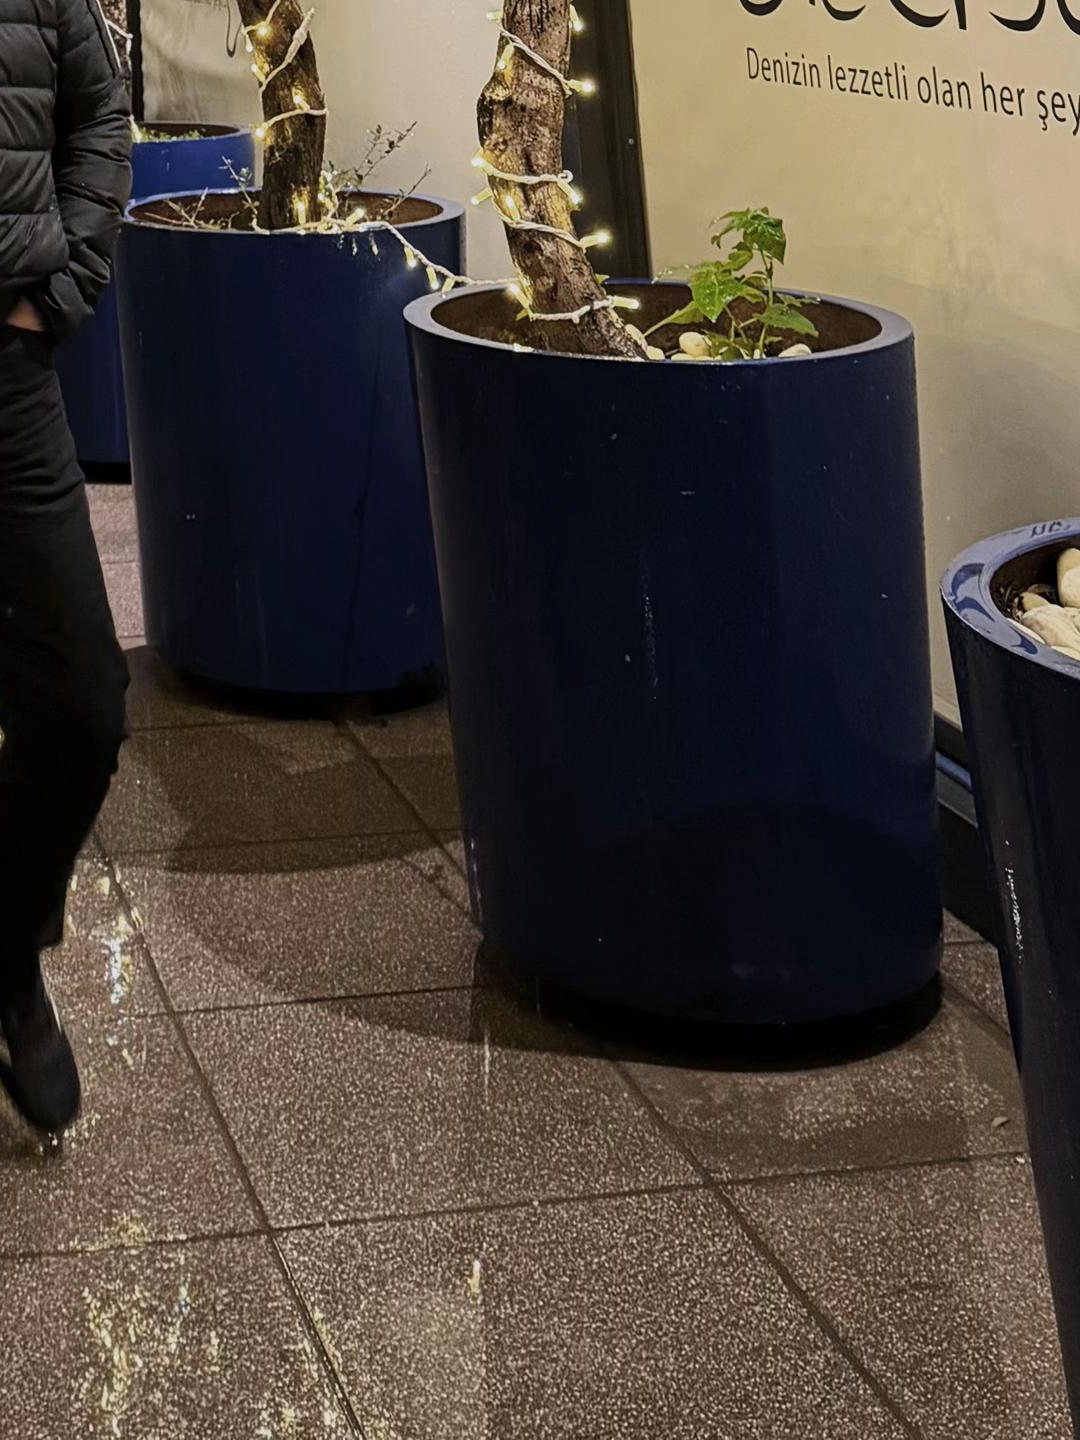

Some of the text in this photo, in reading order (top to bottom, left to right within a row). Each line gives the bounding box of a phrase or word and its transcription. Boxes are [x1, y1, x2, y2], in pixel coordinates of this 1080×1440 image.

[746, 47, 821, 89] Denizin
[827, 54, 909, 101] lezzetli
[917, 66, 972, 110] olan
[980, 71, 1025, 117] her
